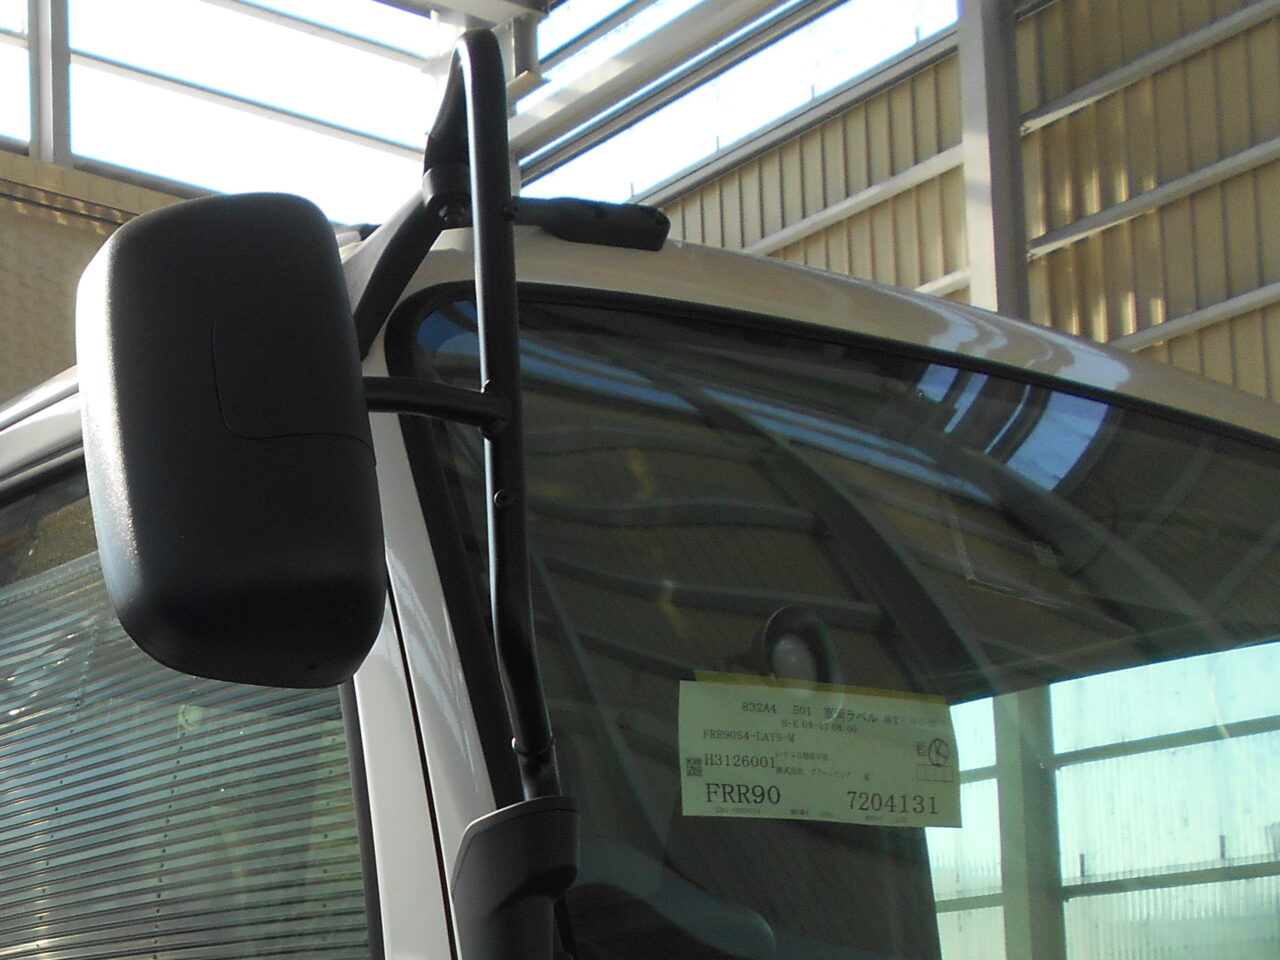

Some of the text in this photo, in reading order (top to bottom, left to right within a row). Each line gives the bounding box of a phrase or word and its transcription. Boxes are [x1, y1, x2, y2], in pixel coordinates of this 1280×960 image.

[791, 704, 812, 716] 501
[704, 753, 777, 769] H3126001
[705, 783, 782, 805] FRR90
[846, 790, 939, 815] 7204131
